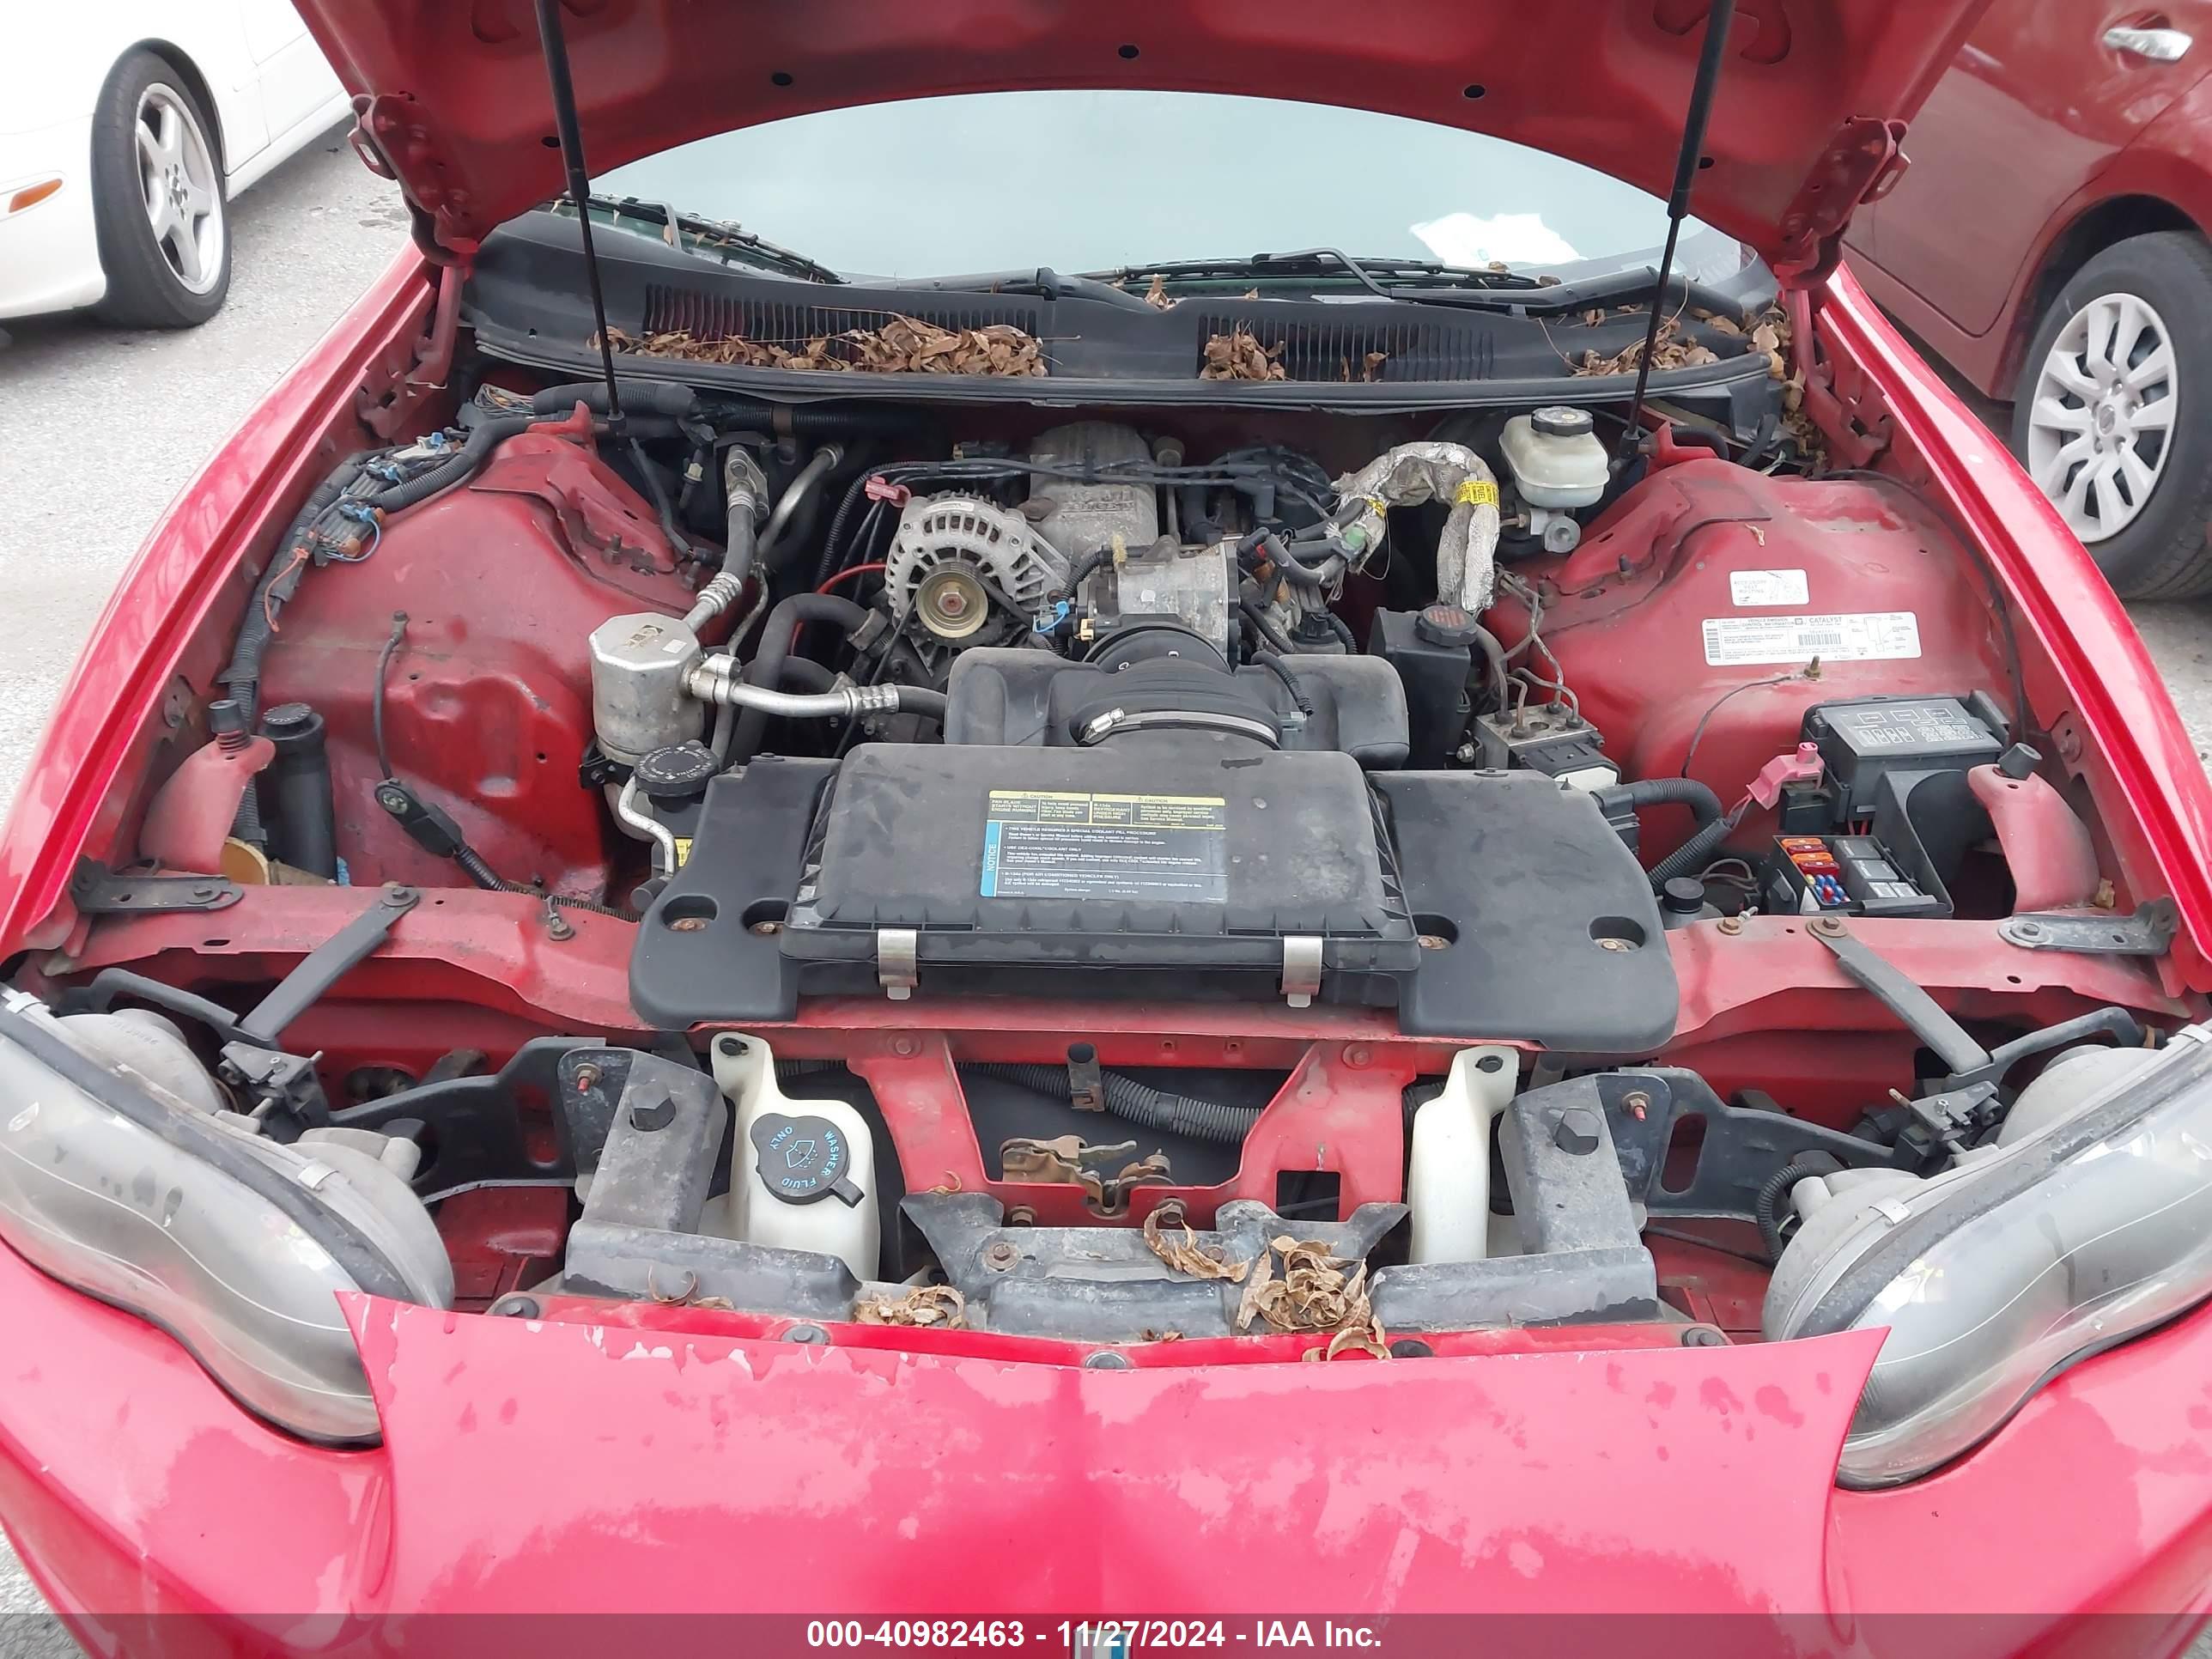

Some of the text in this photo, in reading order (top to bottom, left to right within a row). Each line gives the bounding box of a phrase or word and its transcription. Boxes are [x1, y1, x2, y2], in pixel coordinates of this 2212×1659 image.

[987, 843, 997, 872] NOTICE
[769, 1126, 841, 1190] WASHER FLUID ONLY
